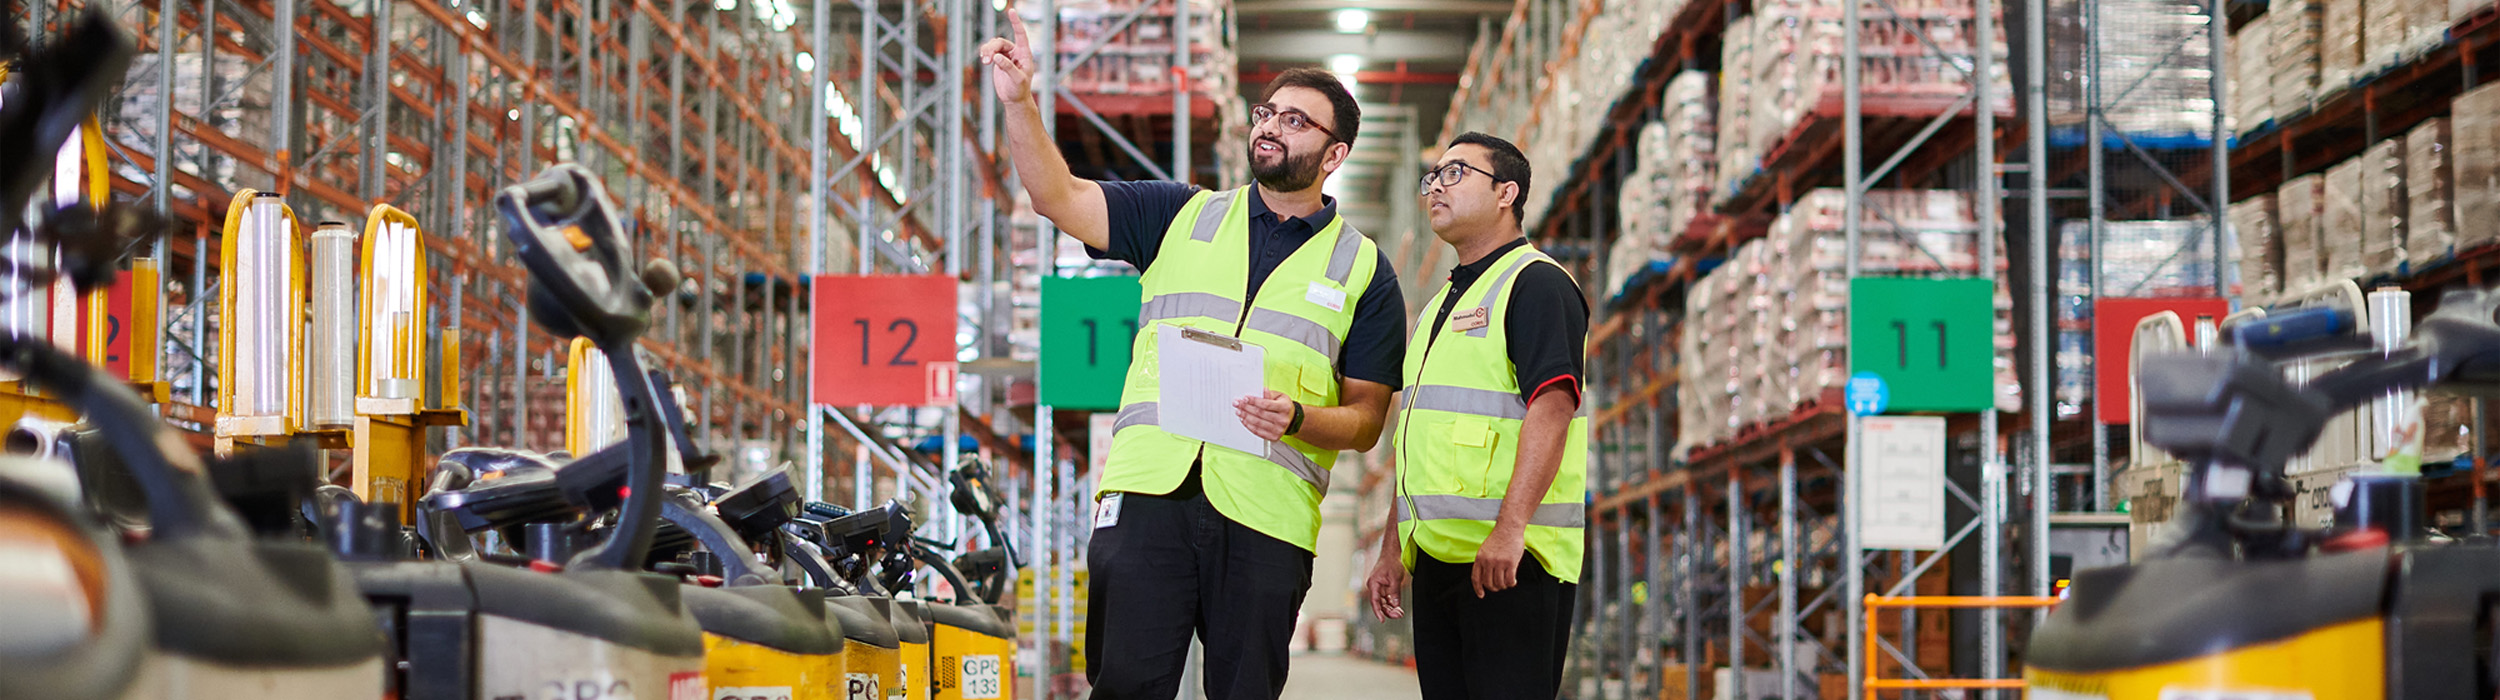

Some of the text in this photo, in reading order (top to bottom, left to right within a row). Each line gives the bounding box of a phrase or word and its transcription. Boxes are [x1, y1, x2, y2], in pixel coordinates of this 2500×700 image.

[854, 318, 918, 366] 12
[1081, 319, 1136, 365] 11
[1890, 320, 1946, 368] 11
[969, 678, 997, 694] 133
